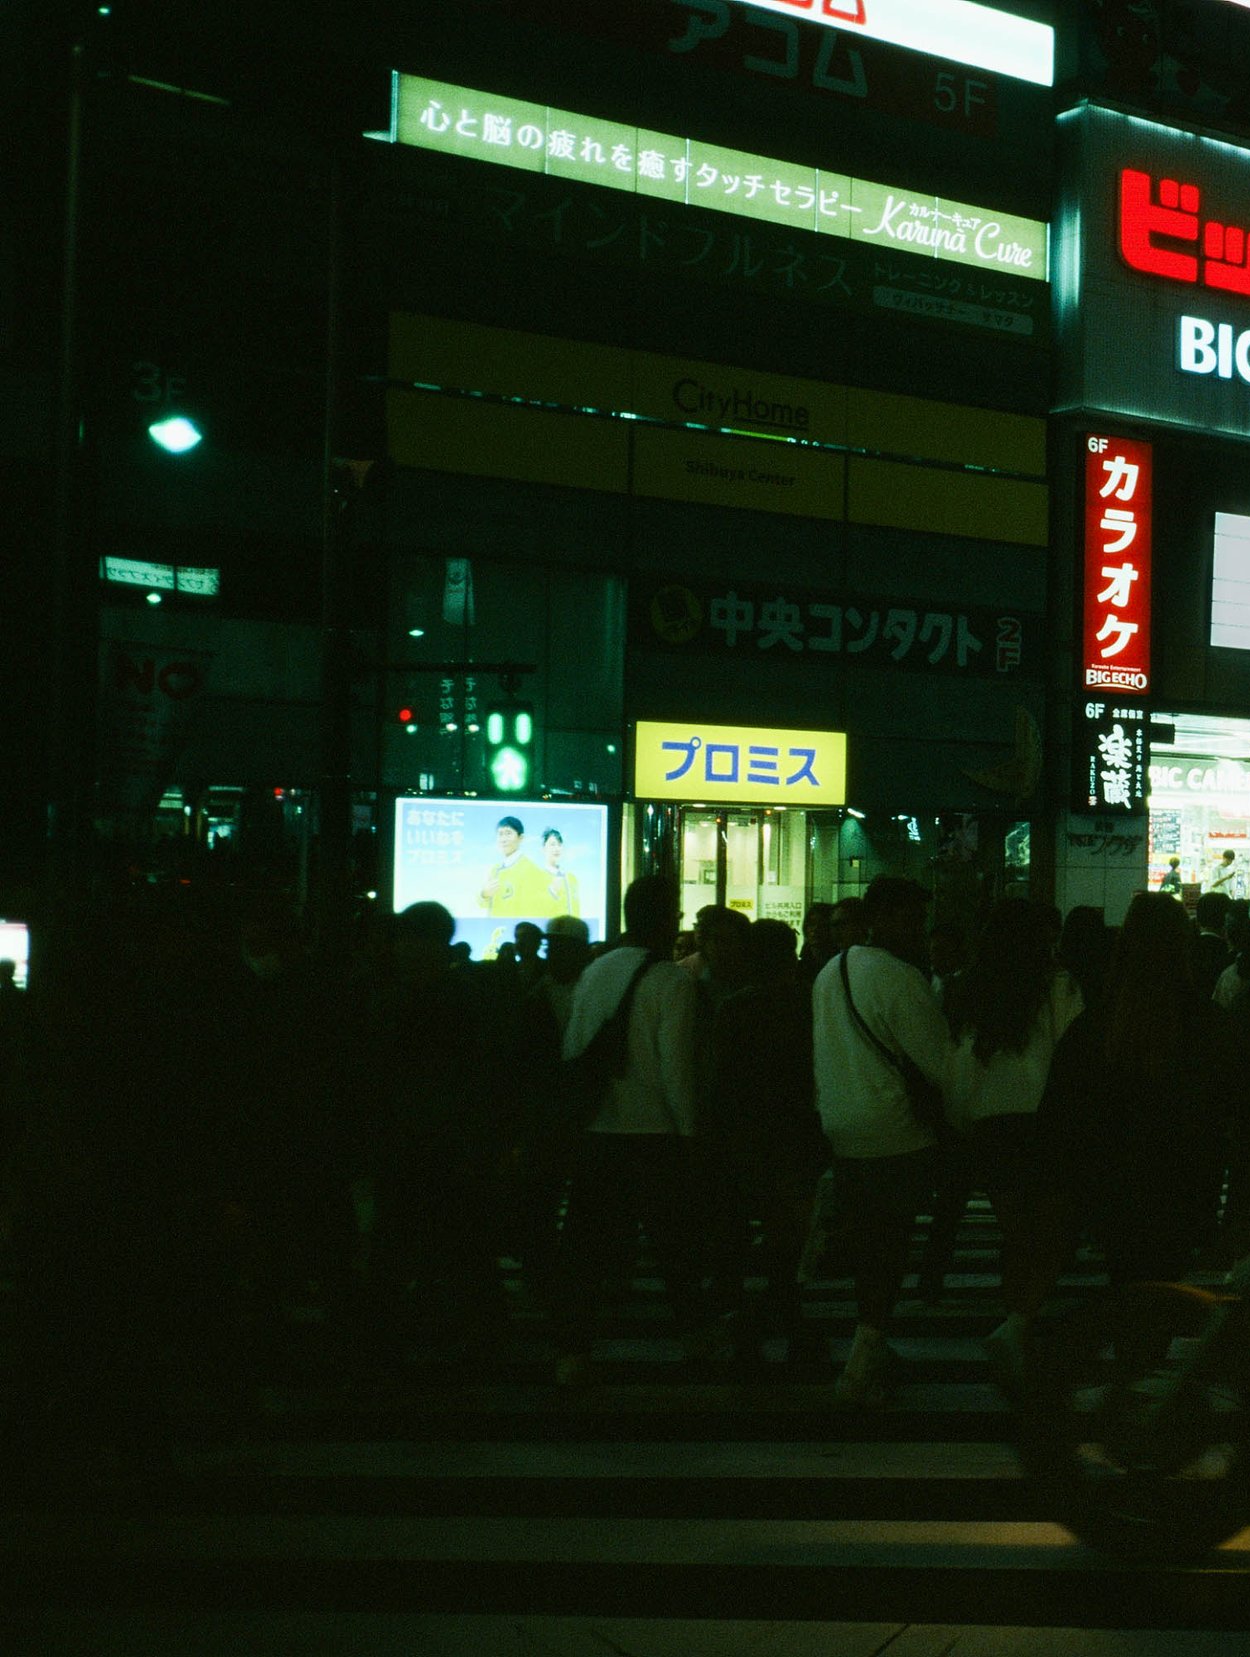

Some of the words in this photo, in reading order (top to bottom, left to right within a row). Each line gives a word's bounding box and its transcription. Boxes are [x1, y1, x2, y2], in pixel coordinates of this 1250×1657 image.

[667, 0, 868, 98] アコム
[933, 71, 987, 116] 5F
[420, 99, 863, 217] 心と脳の疲れを癒すタッチセラピー
[974, 222, 1033, 268] Cure
[672, 377, 810, 425] CityHome
[1087, 437, 1109, 454] 6F
[1095, 454, 1139, 660] カラオケ
[709, 590, 985, 669] 中央コンタクト
[115, 653, 203, 702] NO
[1085, 702, 1106, 719] 6F
[661, 736, 822, 789] プロミス
[1097, 723, 1133, 810] 楽蔵
[1149, 765, 1184, 788] BIC
